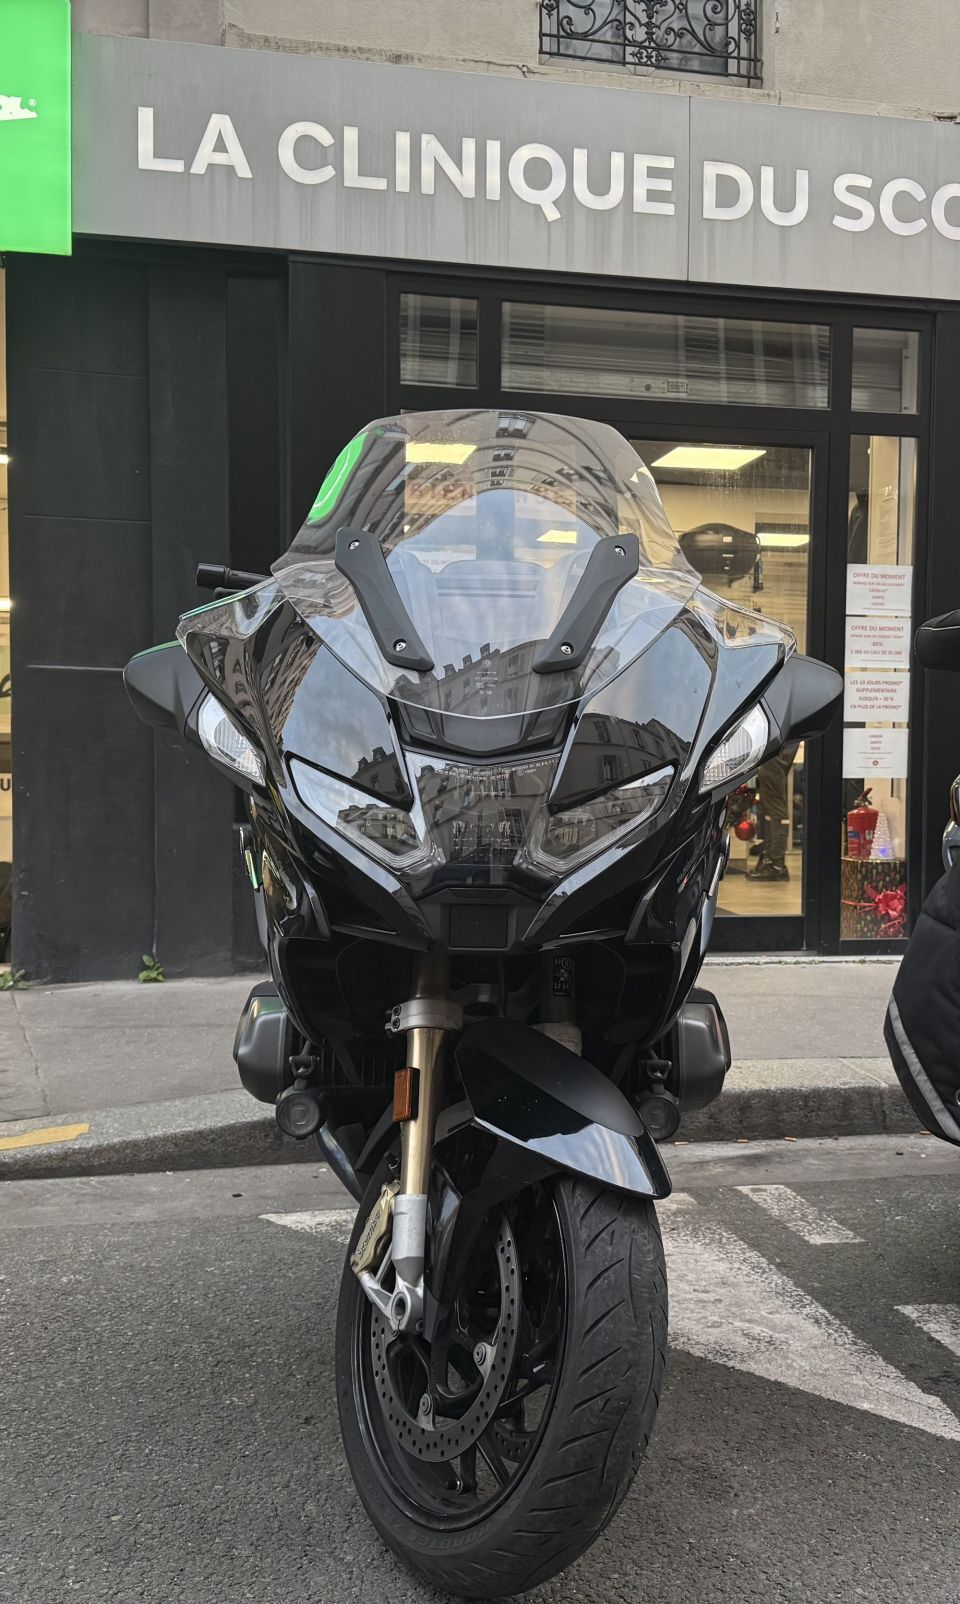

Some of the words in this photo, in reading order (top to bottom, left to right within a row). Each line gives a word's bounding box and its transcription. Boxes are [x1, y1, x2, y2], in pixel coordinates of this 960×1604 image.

[137, 106, 253, 178] LA
[277, 120, 675, 223] CLINIQUE
[702, 160, 809, 227] DU
